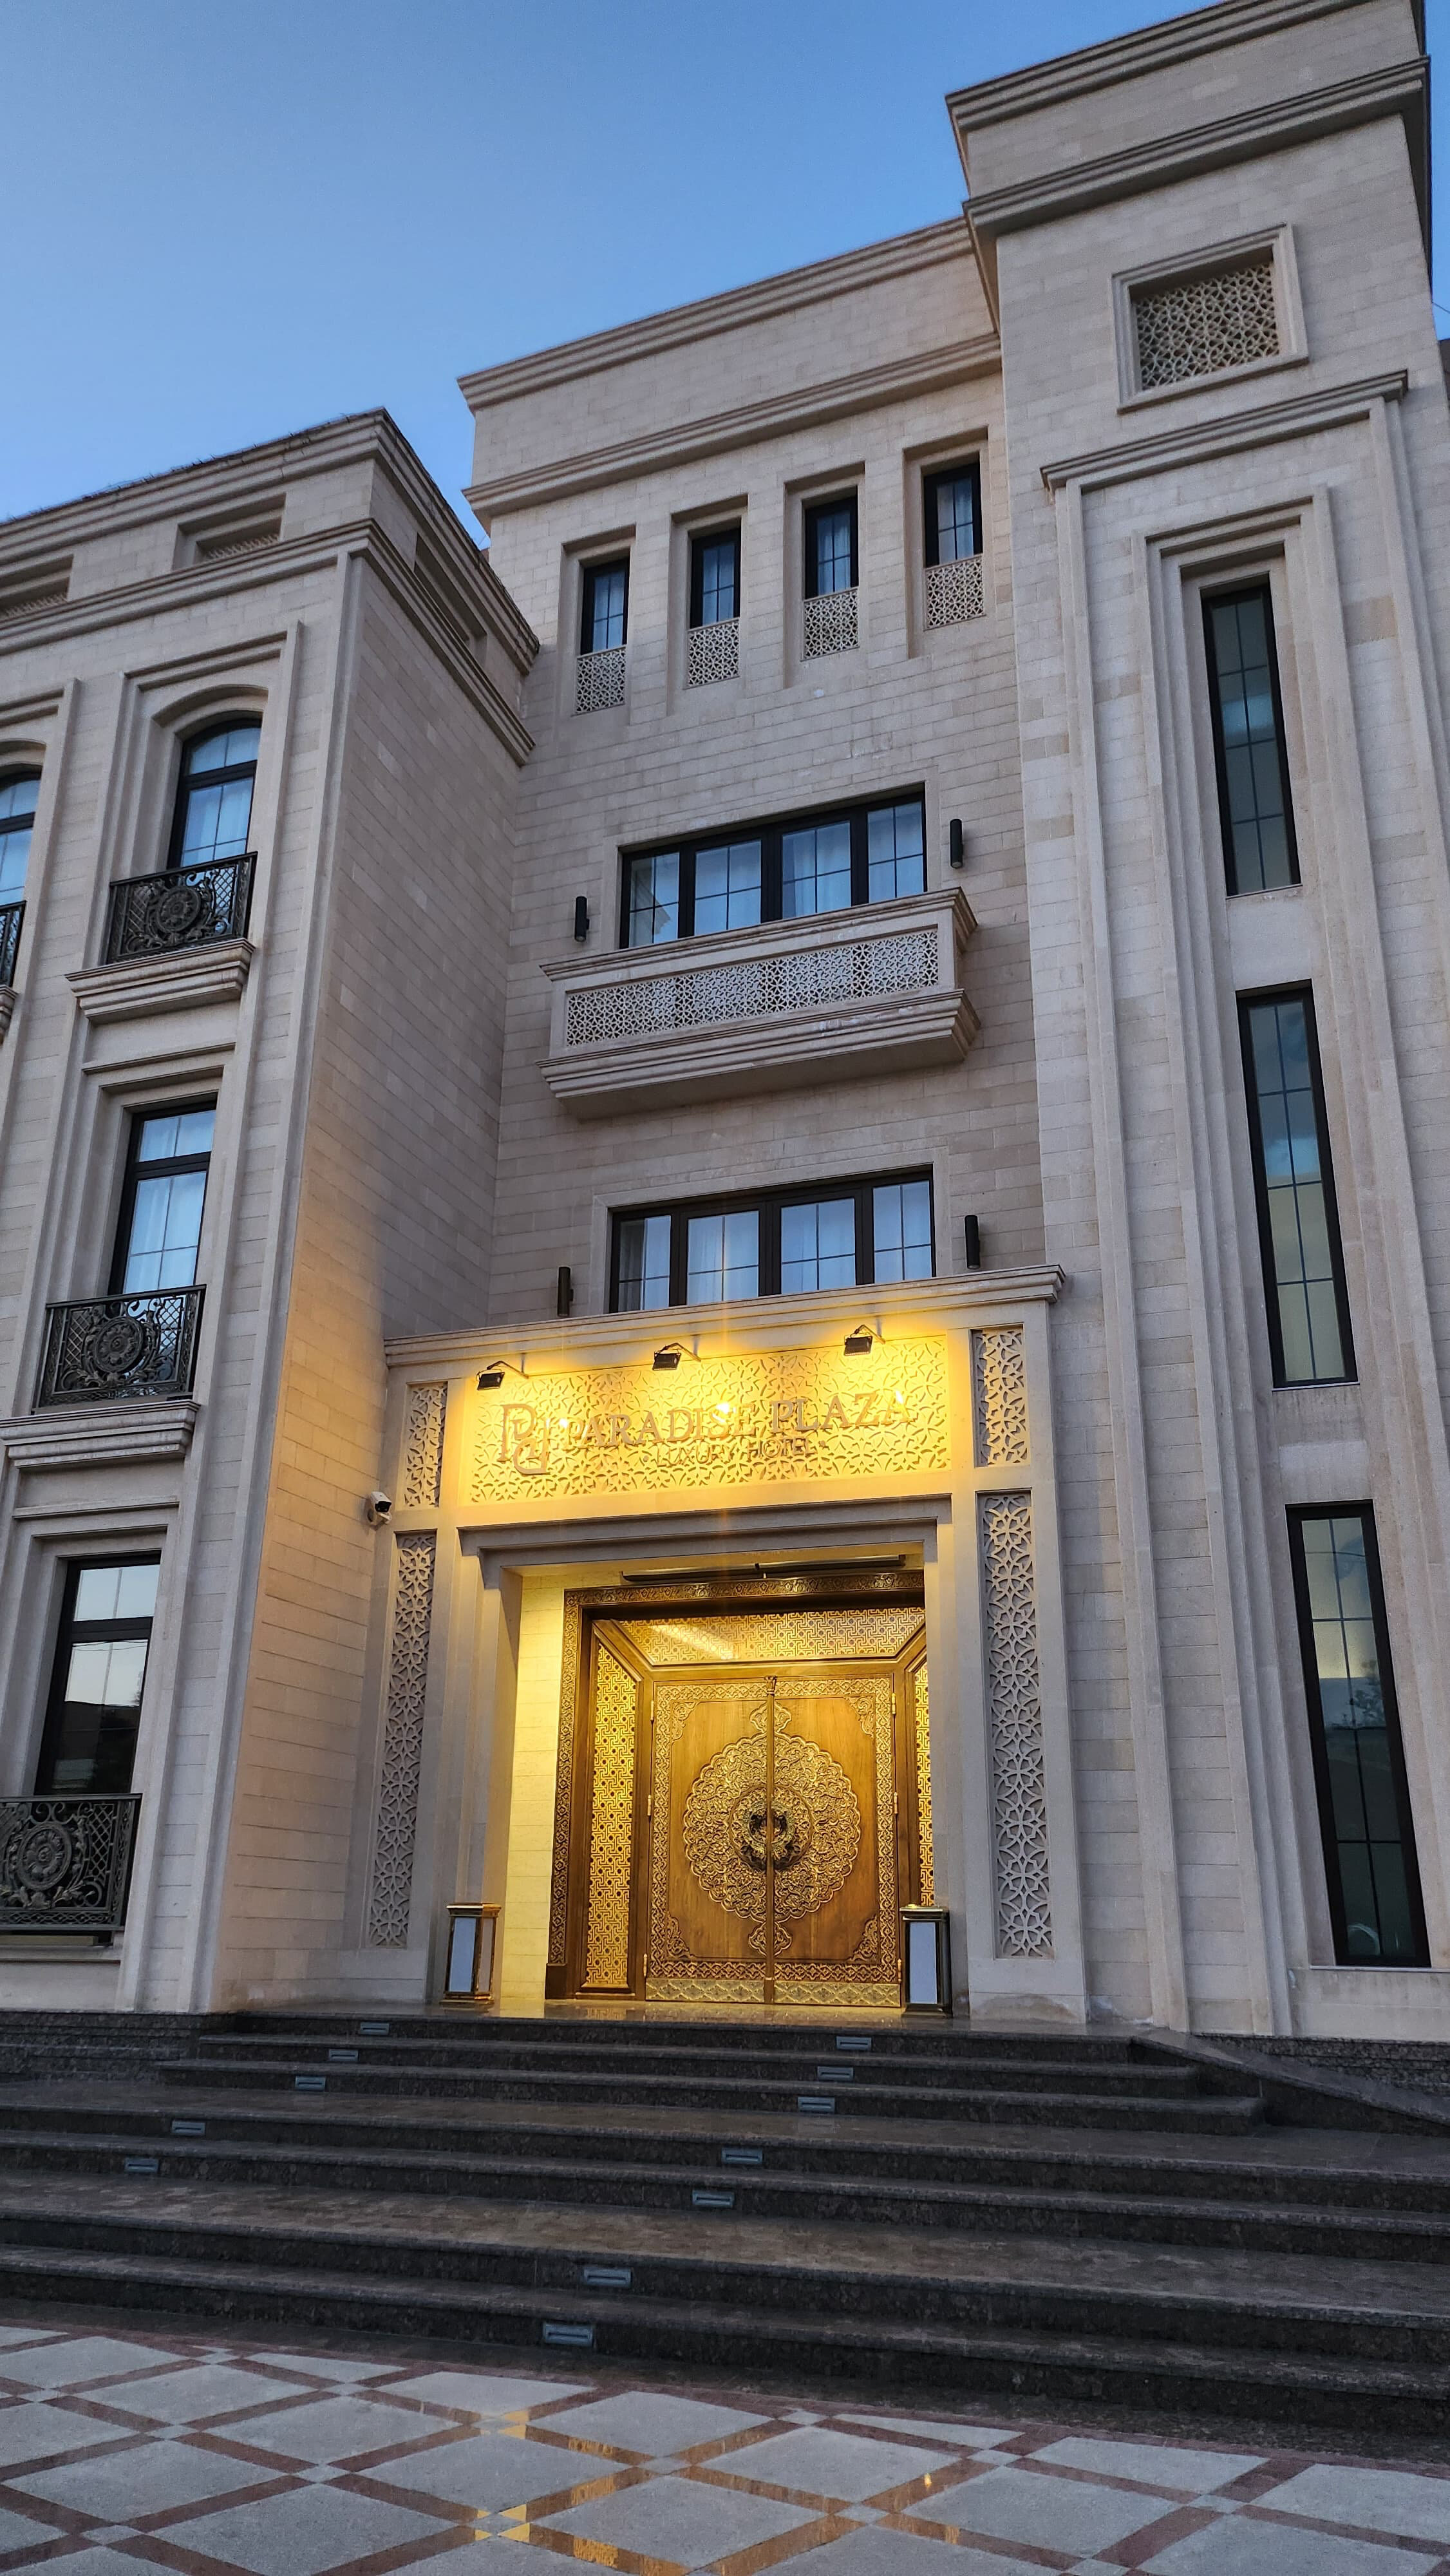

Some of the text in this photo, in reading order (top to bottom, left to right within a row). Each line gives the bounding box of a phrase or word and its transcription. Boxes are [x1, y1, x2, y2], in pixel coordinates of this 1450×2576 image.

[563, 1390, 916, 1450] PARADISE PLAZA
[655, 1437, 818, 1467] LUXURY HOTEL
